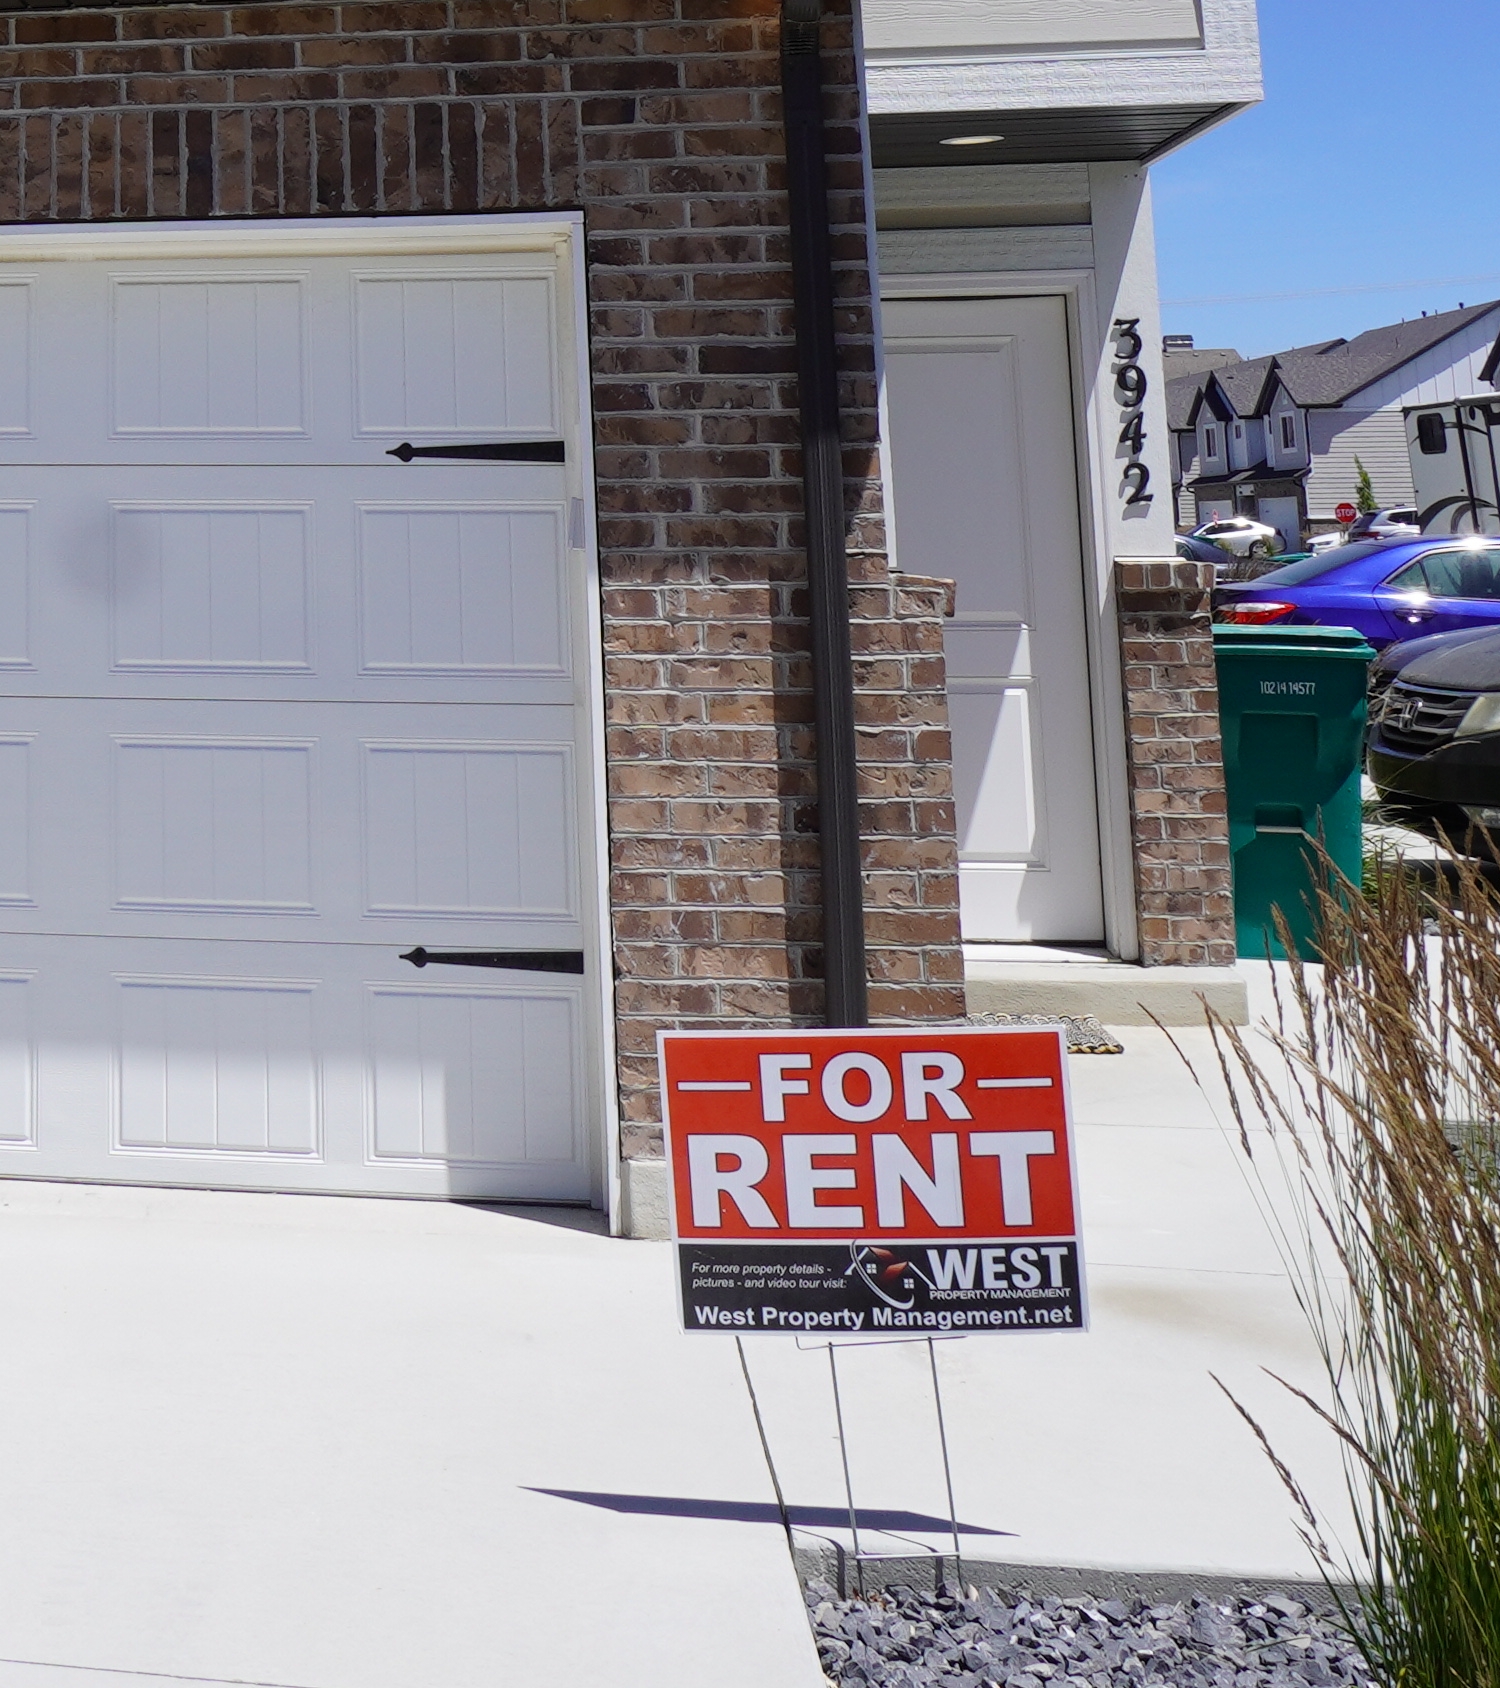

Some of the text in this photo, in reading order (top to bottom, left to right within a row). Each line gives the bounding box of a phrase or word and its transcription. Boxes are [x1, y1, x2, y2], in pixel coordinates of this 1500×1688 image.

[1113, 317, 1154, 505] 3942
[1336, 508, 1355, 517] STOP
[758, 1051, 973, 1123] FOR
[687, 1130, 1056, 1229] RENT
[691, 1262, 711, 1273] For
[712, 1265, 740, 1274] more
[742, 1264, 787, 1276] property
[788, 1263, 825, 1274] details
[926, 1246, 1069, 1290] WEST
[692, 1278, 735, 1289] pictures
[744, 1277, 765, 1288] and
[767, 1277, 797, 1288] video
[799, 1278, 820, 1288] tour
[929, 1288, 1071, 1300] PROPERTY MANAGEMENT
[694, 1305, 1073, 1330] West Property Management.net
